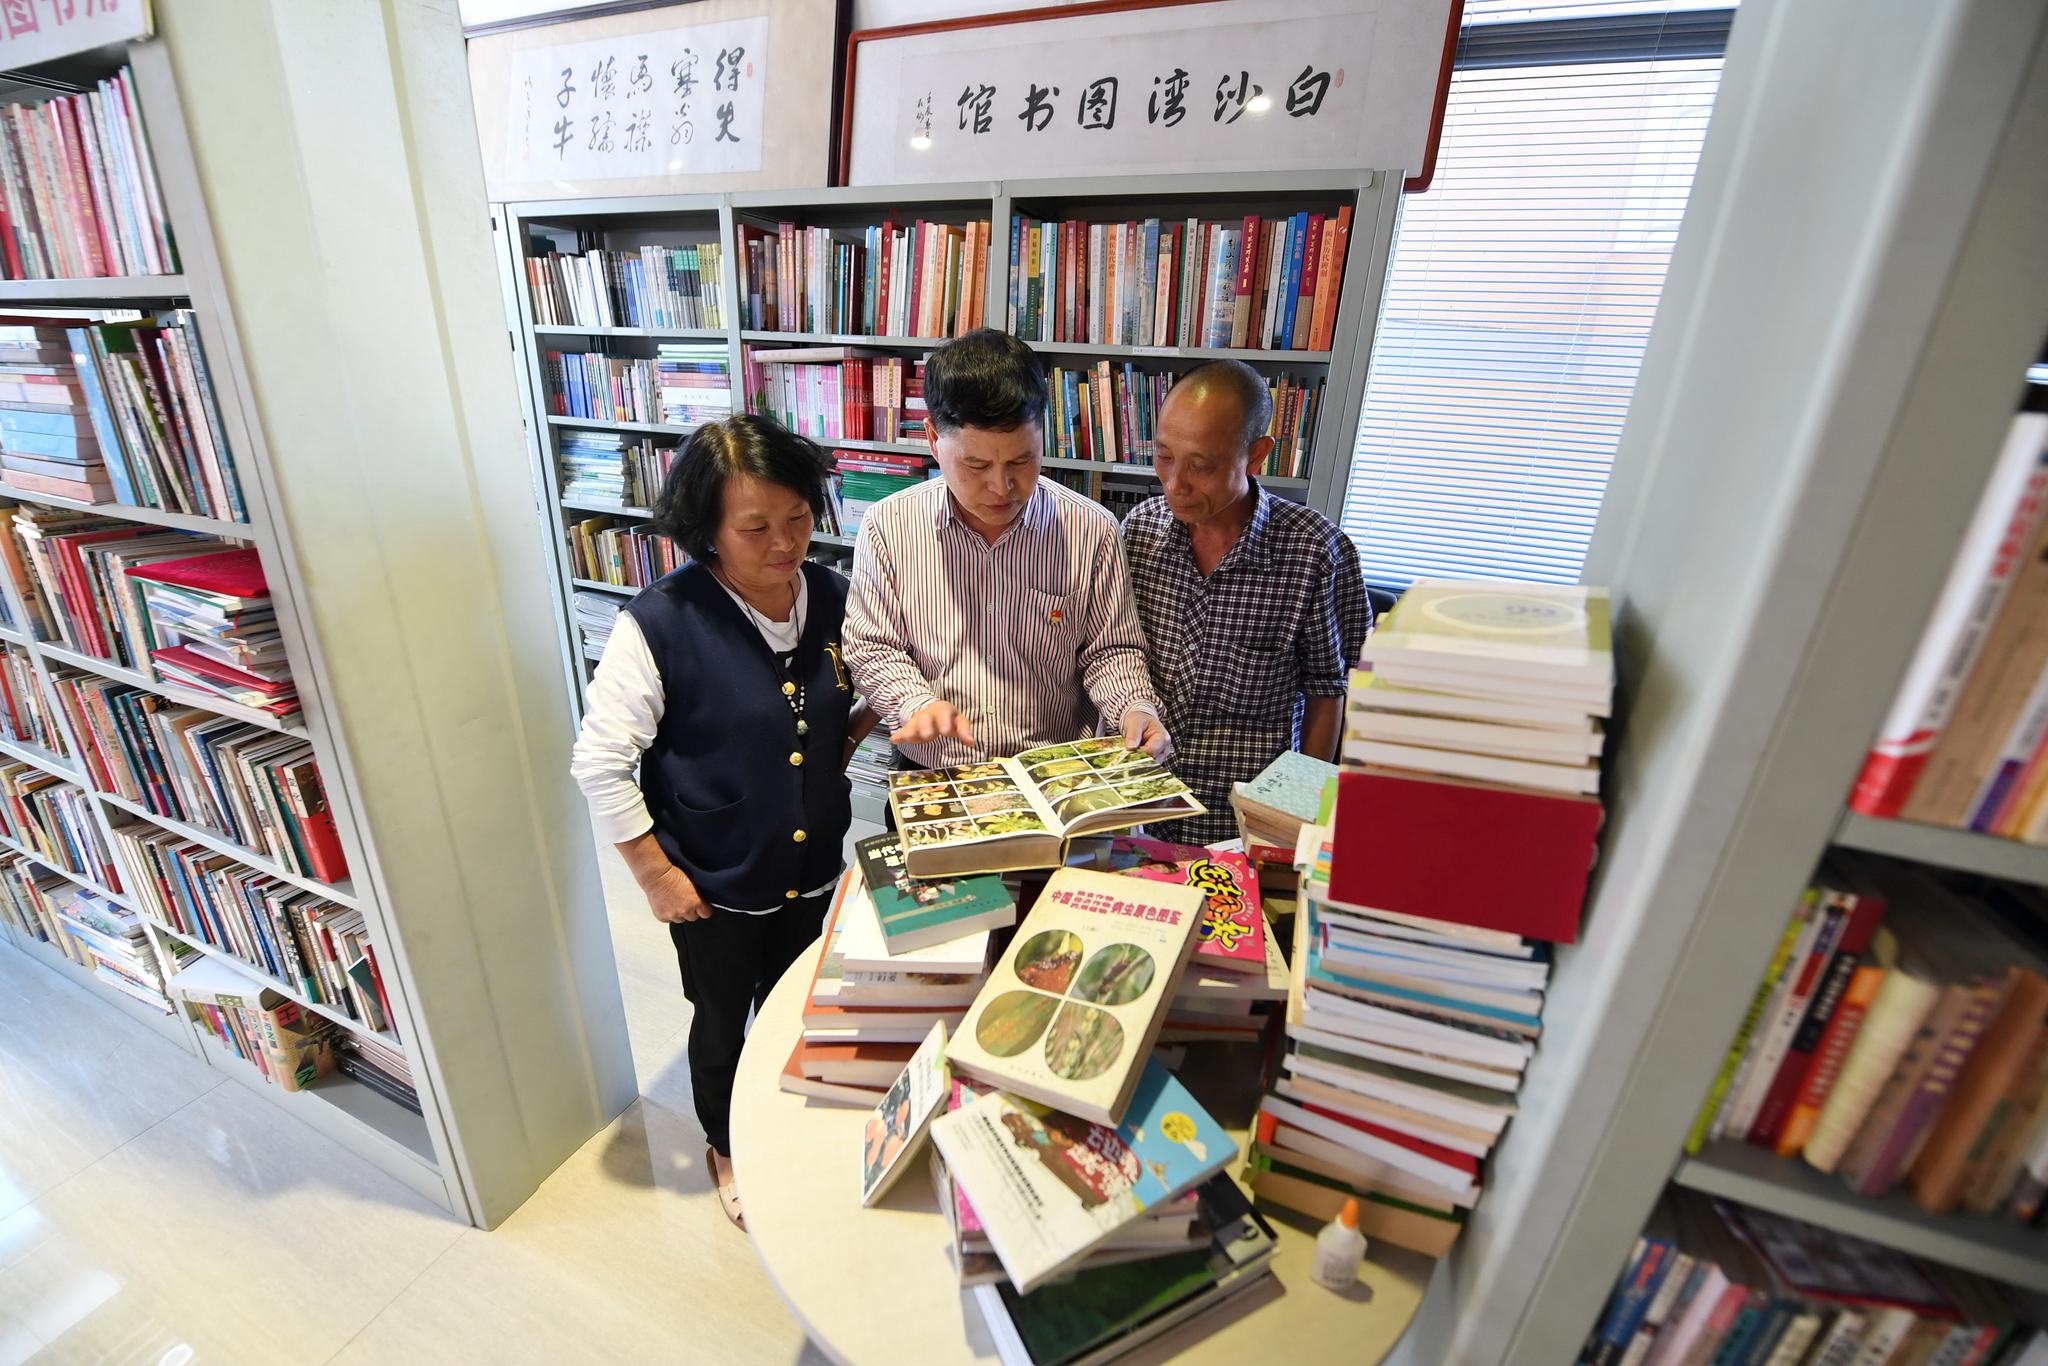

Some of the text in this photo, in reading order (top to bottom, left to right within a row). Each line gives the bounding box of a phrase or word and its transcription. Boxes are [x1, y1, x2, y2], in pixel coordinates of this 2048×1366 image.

[957, 64, 1331, 134] 白沙湾图书馆
